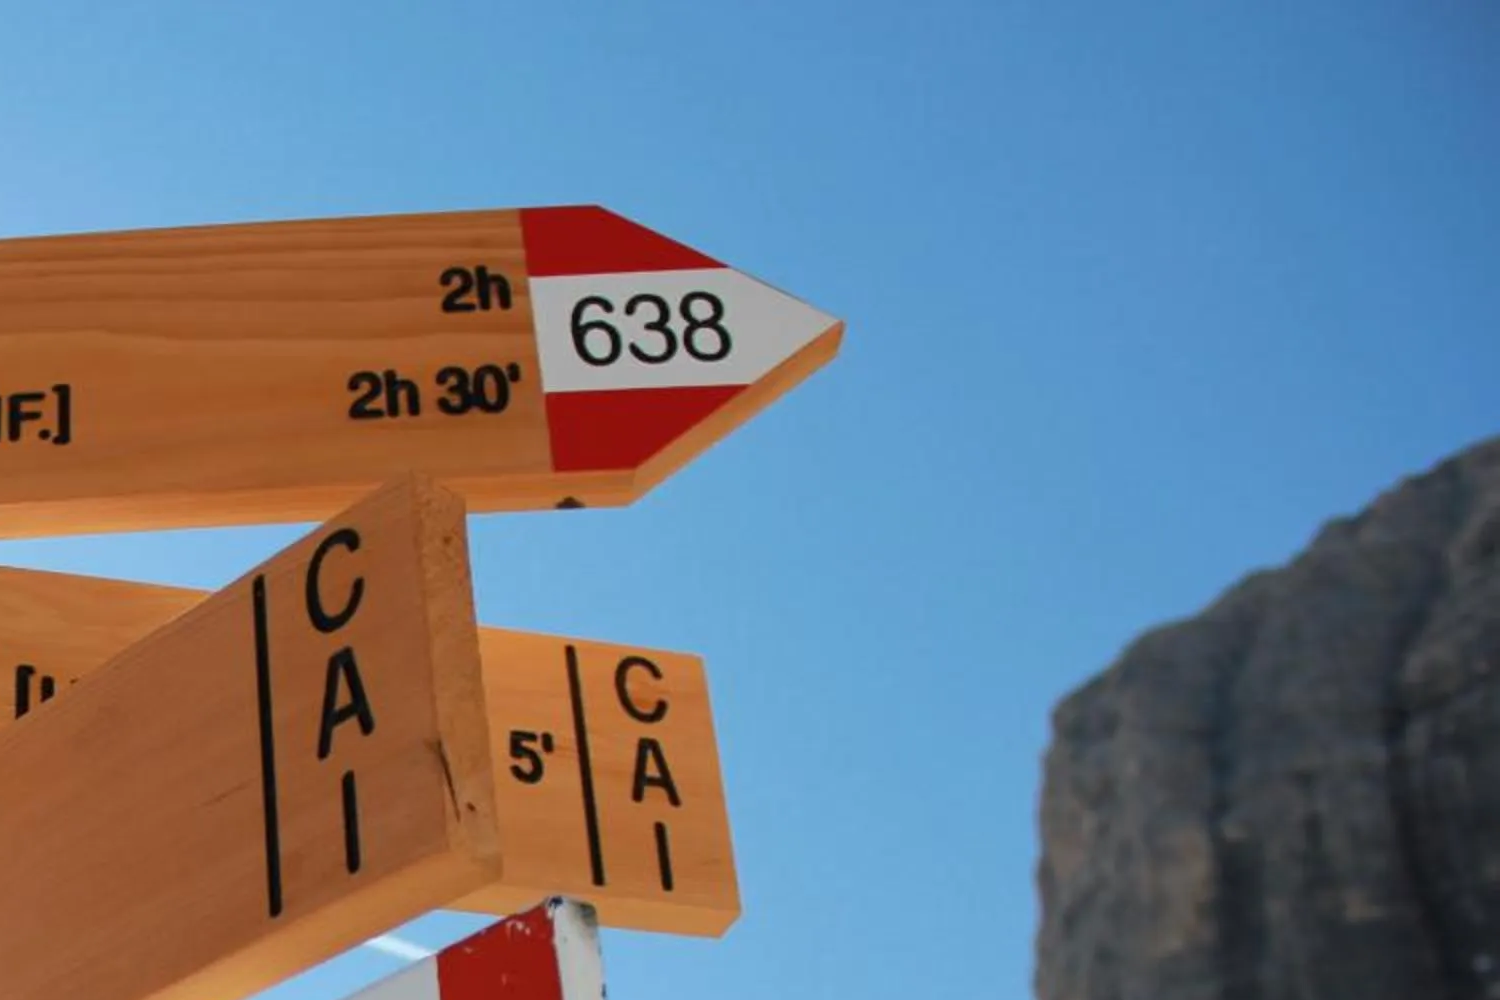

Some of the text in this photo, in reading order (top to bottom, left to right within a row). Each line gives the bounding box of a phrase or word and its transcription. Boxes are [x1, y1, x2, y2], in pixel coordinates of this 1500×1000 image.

[439, 265, 512, 313] 2h
[570, 291, 732, 367] 638
[347, 369, 421, 420] 2h
[435, 362, 521, 416] 30'
